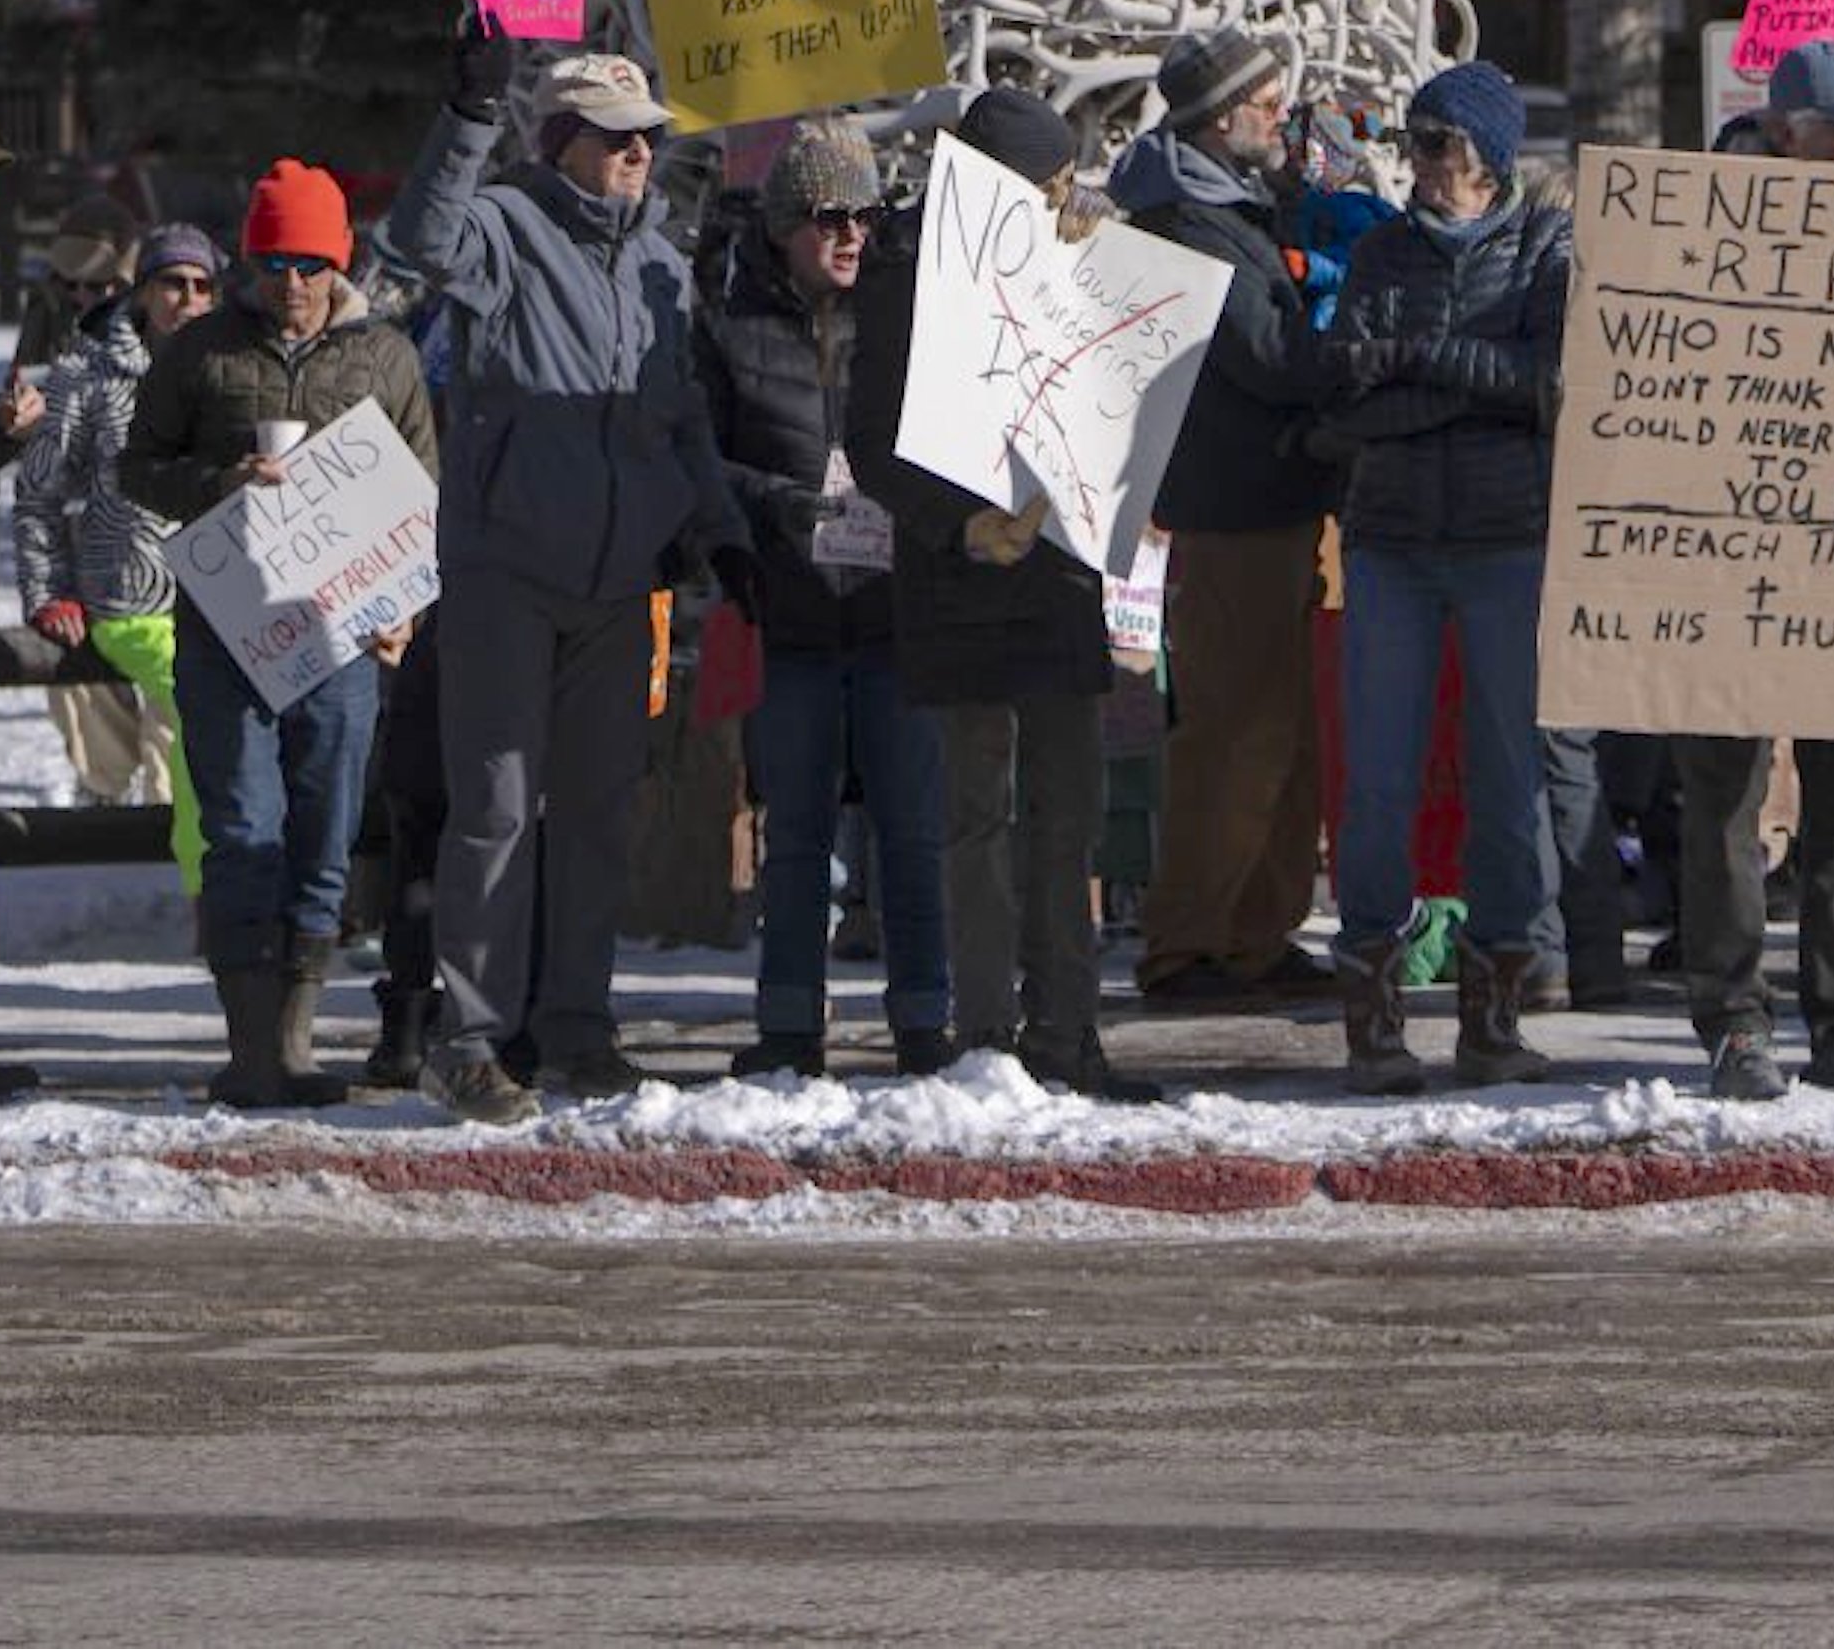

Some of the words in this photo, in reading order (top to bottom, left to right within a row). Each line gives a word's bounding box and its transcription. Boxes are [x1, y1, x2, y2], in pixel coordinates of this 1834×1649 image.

[683, 37, 750, 84] LOCK
[769, 17, 841, 64] THEM
[936, 155, 1035, 283] NO
[1598, 307, 1717, 362] WHO
[1746, 324, 1783, 360] IS
[1613, 370, 1708, 406] DON'T
[1726, 373, 1825, 411] THINK
[1591, 411, 1716, 448] COULD
[1738, 420, 1832, 454] NEVER
[1750, 455, 1808, 482] TO
[189, 421, 381, 576] CITIZENS
[265, 512, 352, 584] FOR
[1581, 520, 1782, 562] IMPEACH
[1569, 606, 1631, 642] ALL
[1654, 609, 1707, 644] HIS
